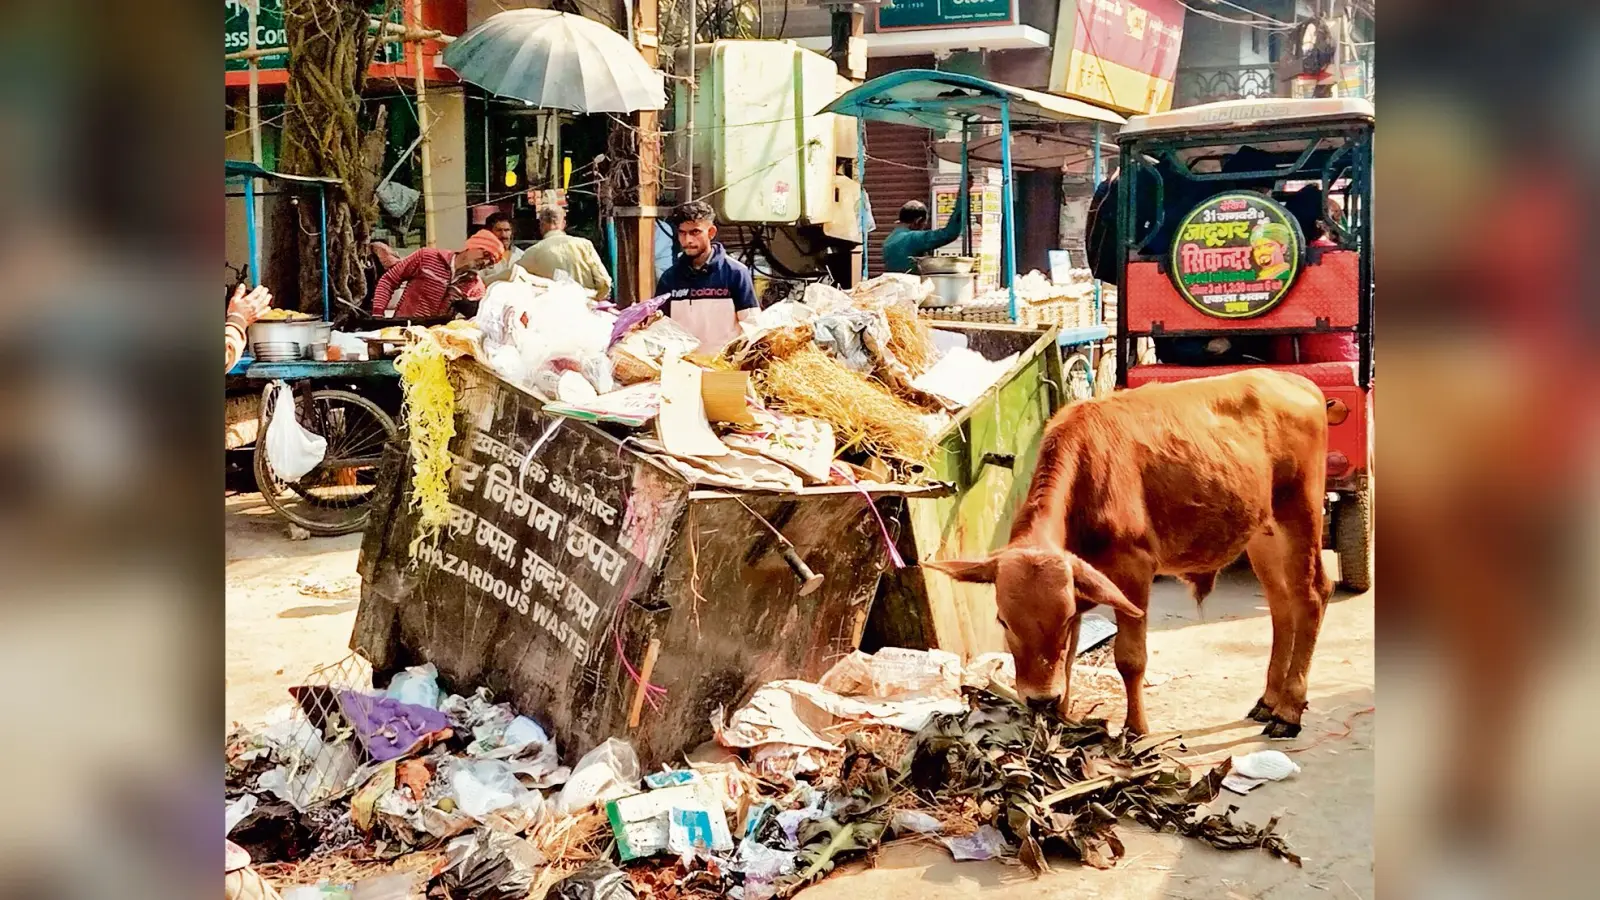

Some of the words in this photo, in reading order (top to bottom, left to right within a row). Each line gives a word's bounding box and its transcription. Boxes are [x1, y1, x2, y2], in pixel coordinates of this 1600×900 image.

[1203, 210, 1216, 221] 31
[1217, 208, 1257, 220] जनवरी
[1184, 221, 1249, 247] जादूगर
[1181, 243, 1252, 273] सिकन्दर
[671, 288, 689, 297] new
[690, 288, 729, 296] balance
[483, 463, 563, 541] निगम
[565, 520, 628, 586] छपरा
[520, 547, 568, 602] सुन्दर
